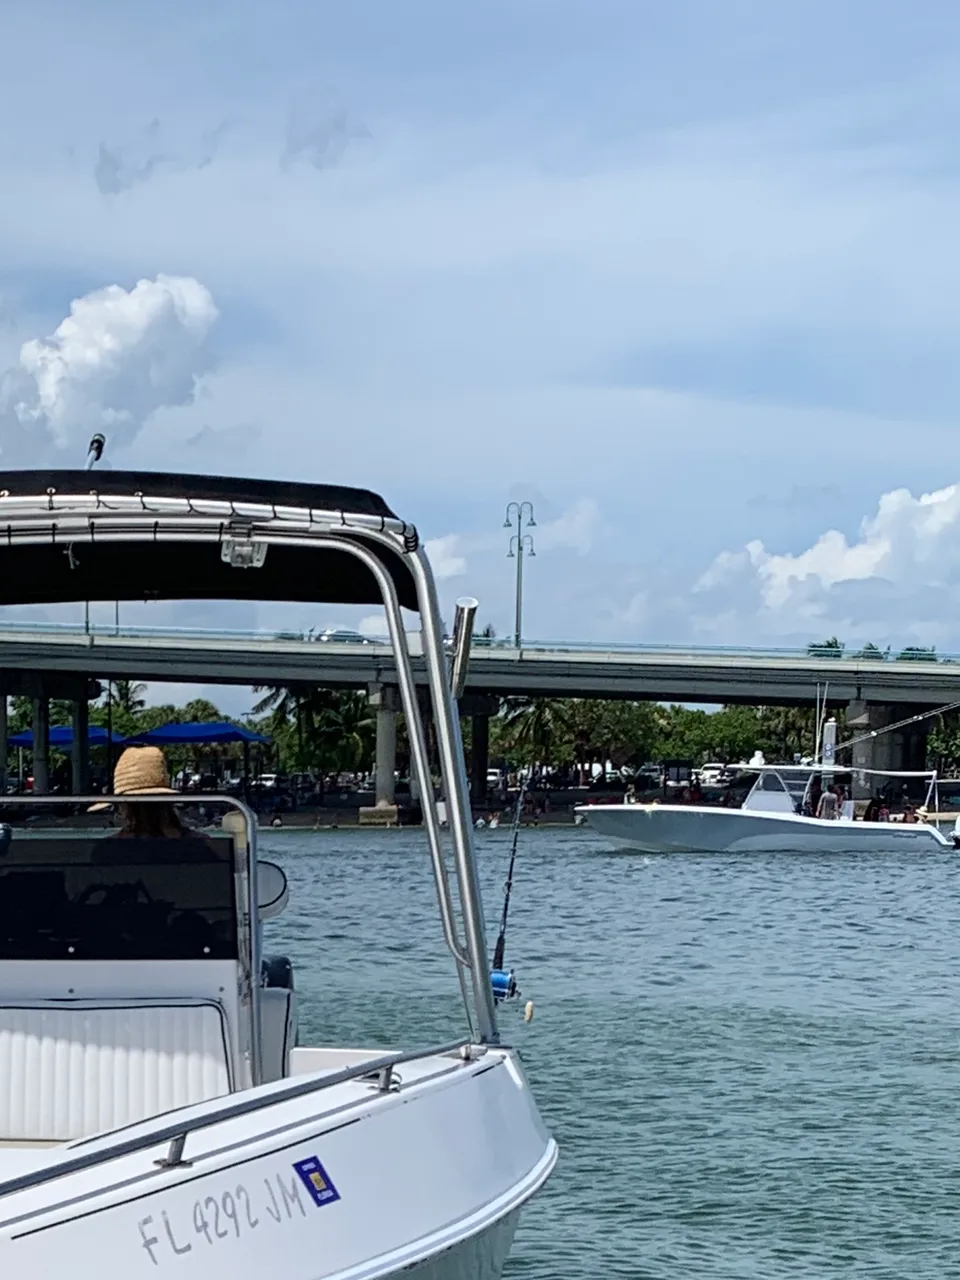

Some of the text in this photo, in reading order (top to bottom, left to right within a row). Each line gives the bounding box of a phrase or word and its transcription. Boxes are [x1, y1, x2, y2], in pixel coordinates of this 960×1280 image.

[138, 1173, 307, 1266] FL 4292 JM
